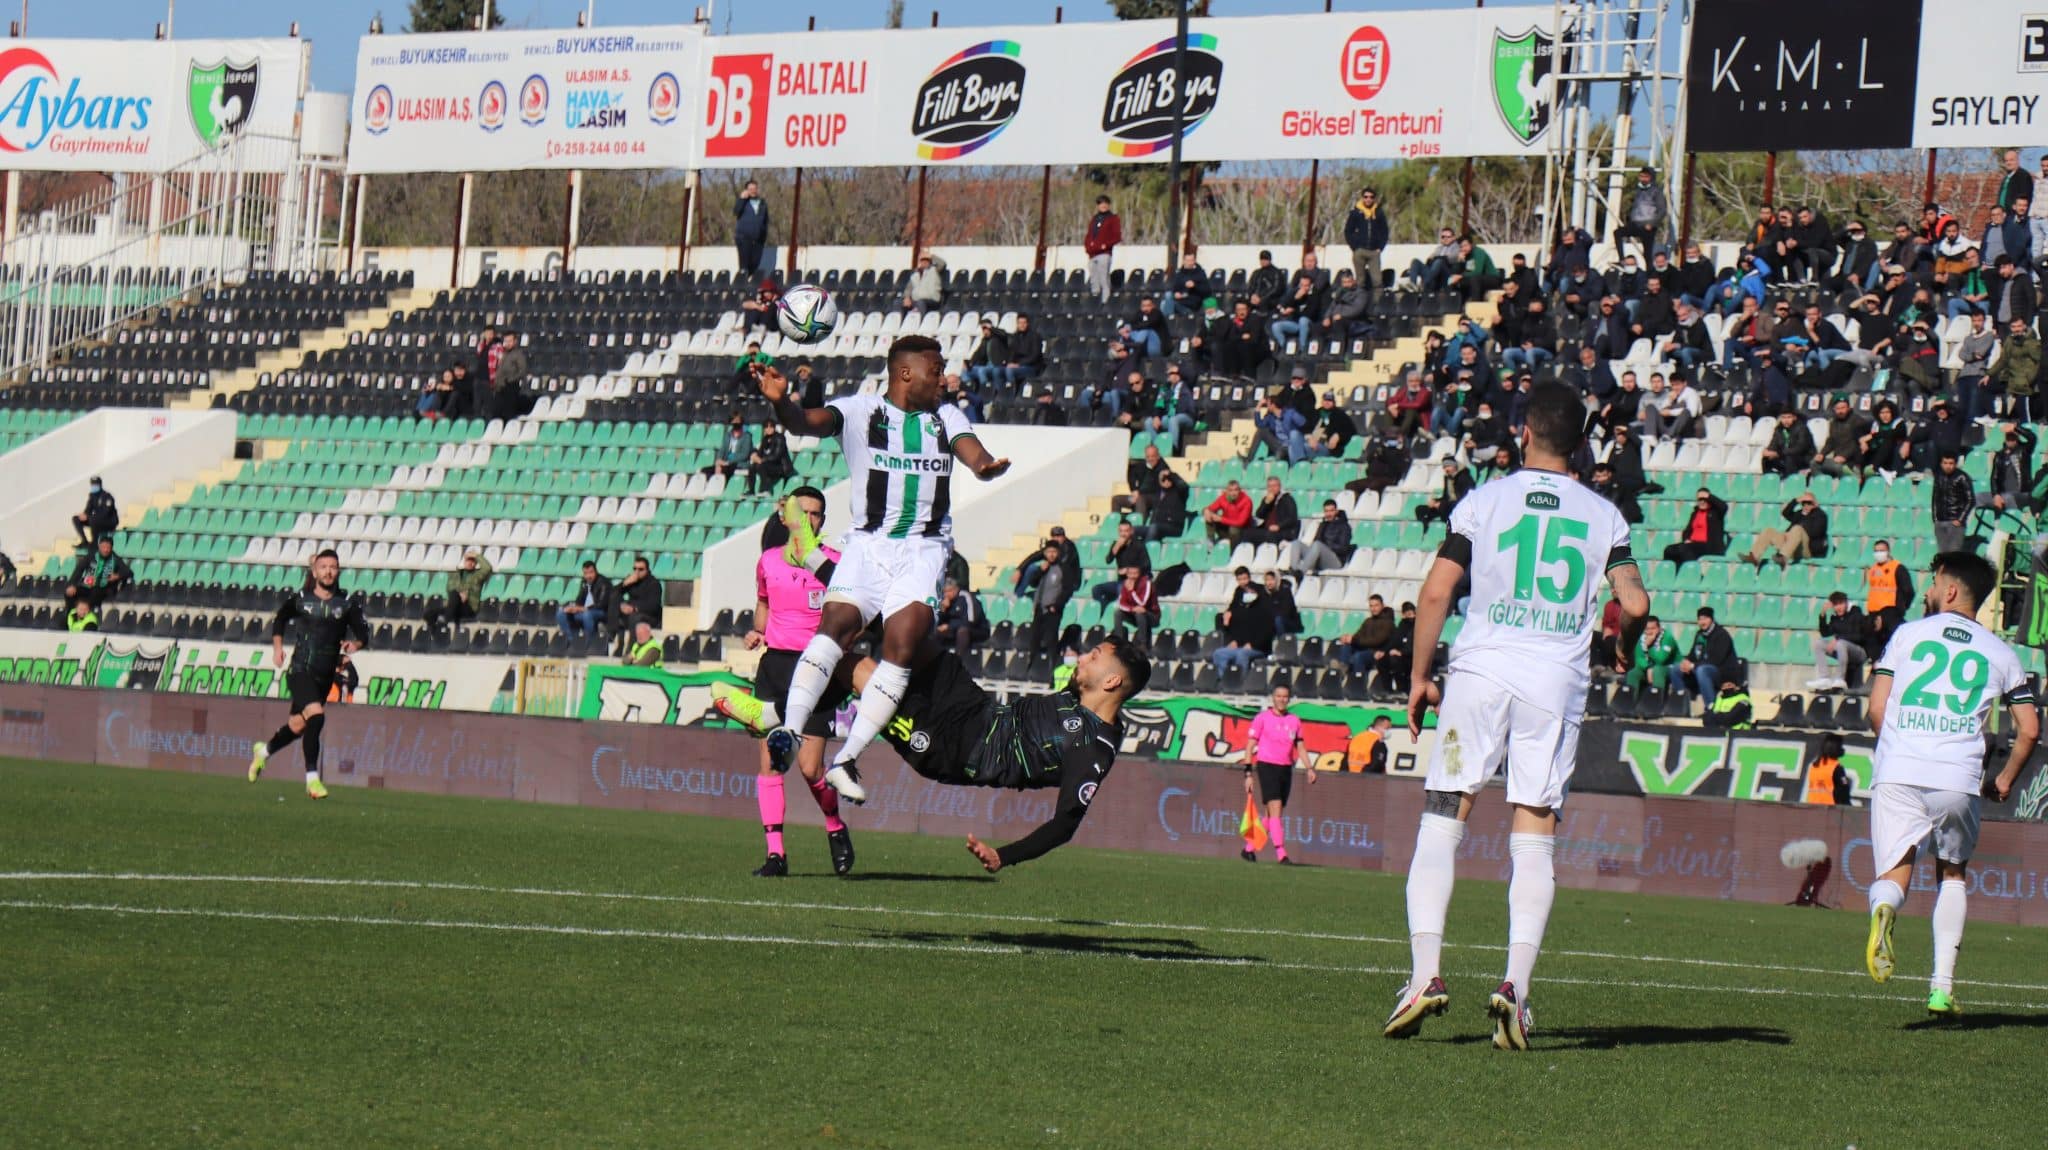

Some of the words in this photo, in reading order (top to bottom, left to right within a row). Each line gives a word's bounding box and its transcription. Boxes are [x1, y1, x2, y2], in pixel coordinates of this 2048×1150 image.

[777, 61, 867, 96] BALTALI
[567, 89, 609, 109] HAVA
[919, 79, 962, 127] Filli
[962, 73, 1019, 121] Boya
[1109, 73, 1155, 122] Filli
[1155, 67, 1217, 114] Bya
[0, 75, 153, 150] Aybars
[1282, 110, 1356, 137] Göksel
[1361, 108, 1443, 136] Tantuni
[1931, 95, 2040, 126] SAYLAY
[785, 112, 847, 148] GRUP
[1373, 364, 1391, 374] 15
[1233, 434, 1249, 446] 12
[1089, 513, 1100, 525] 9
[1497, 513, 1589, 604] 15
[1900, 640, 1989, 716] 29
[1939, 716, 1976, 735] DEPE
[1319, 818, 1376, 848] OTEL
